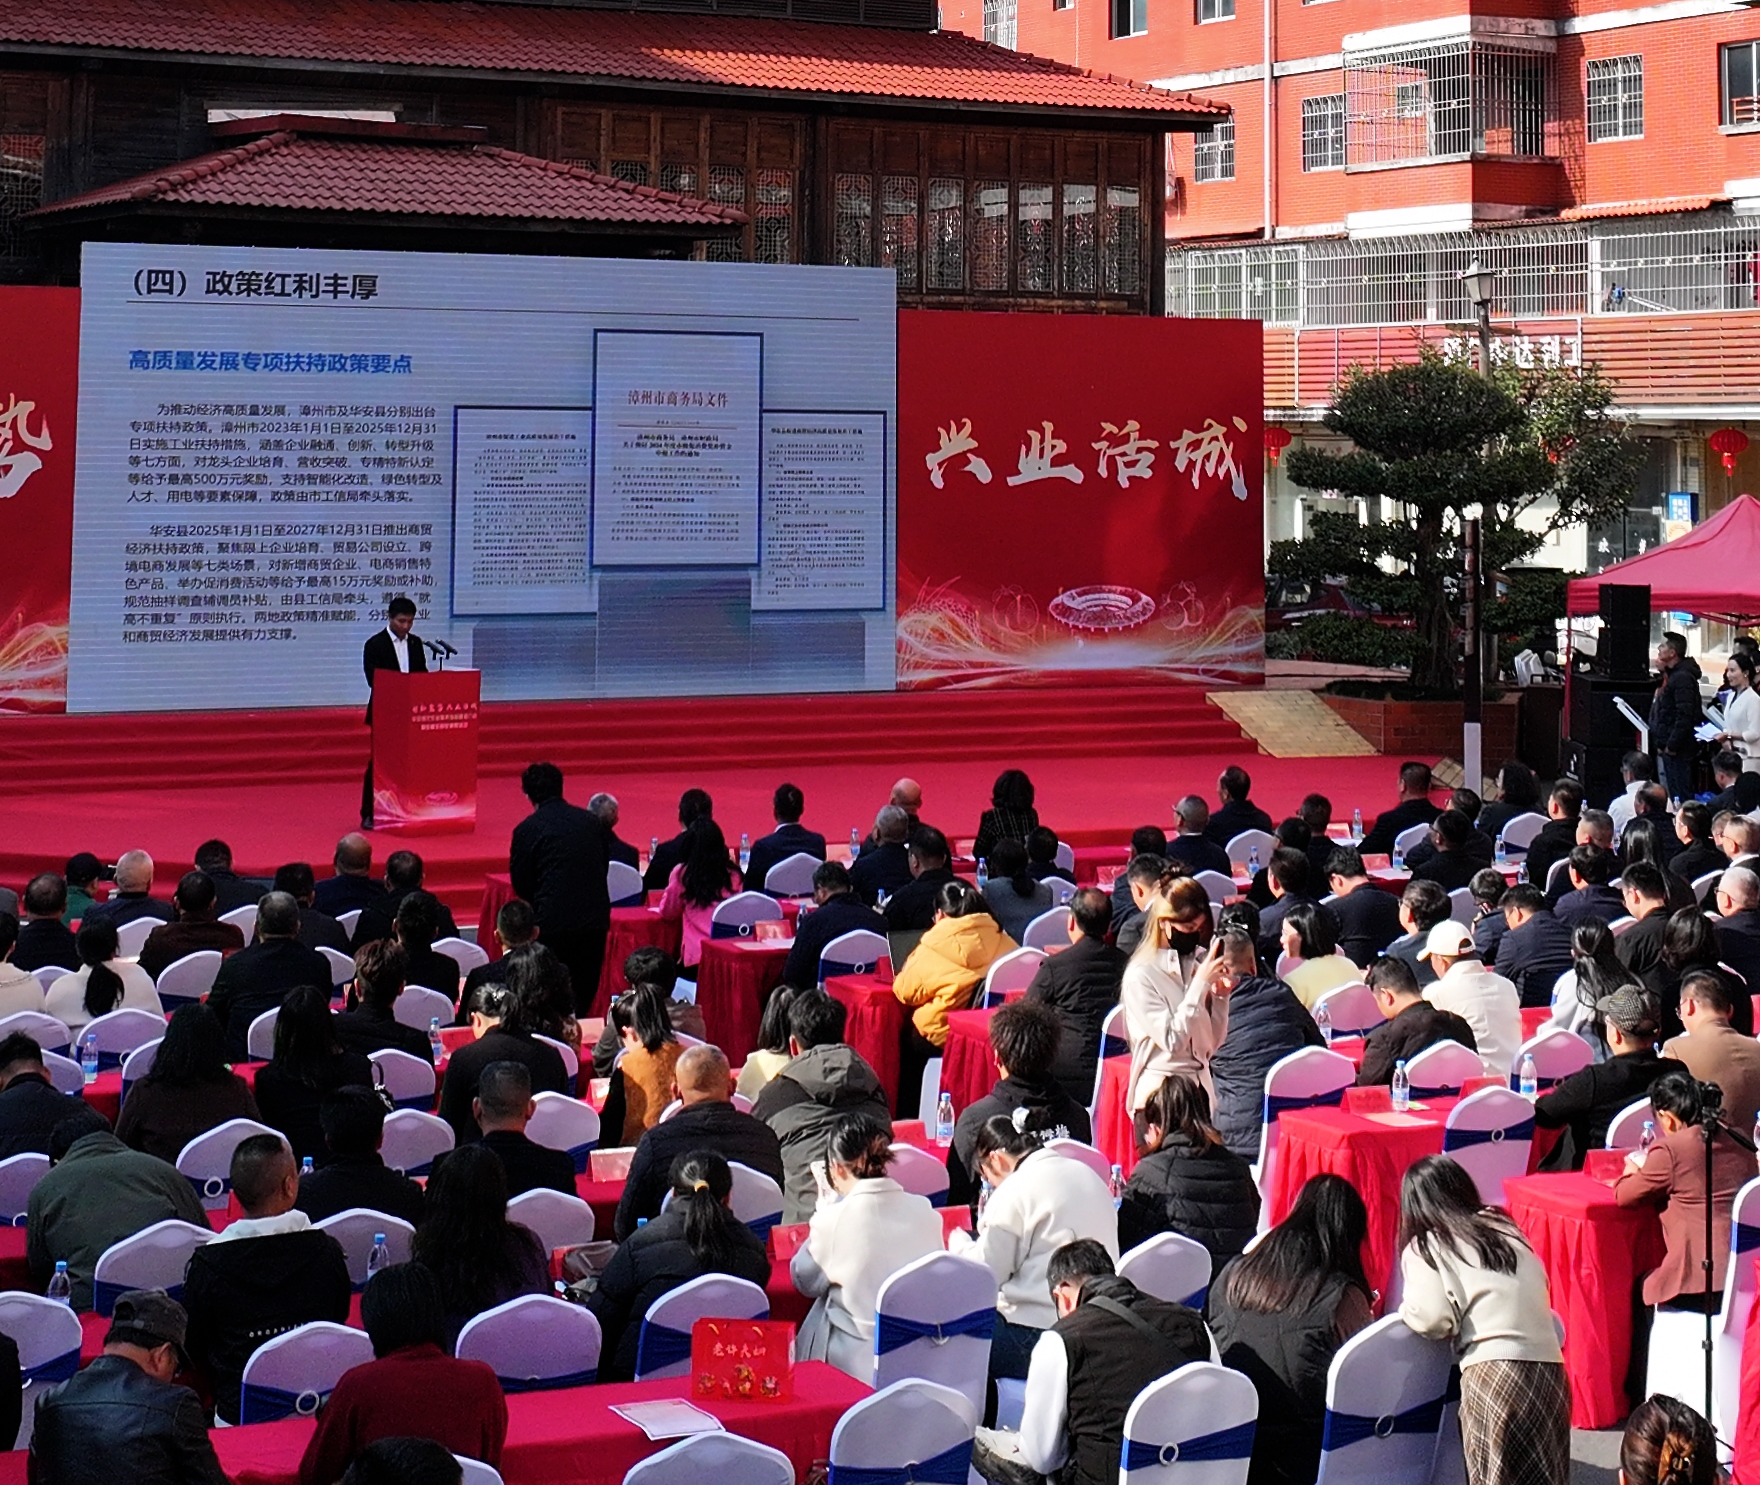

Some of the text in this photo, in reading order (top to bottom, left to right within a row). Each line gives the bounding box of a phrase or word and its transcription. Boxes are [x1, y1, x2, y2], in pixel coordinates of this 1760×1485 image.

[133, 268, 378, 300] （四）政策红利丰厚
[128, 349, 413, 374] 高质量发展专项扶持政策要点
[925, 415, 1249, 502] 兴业活城
